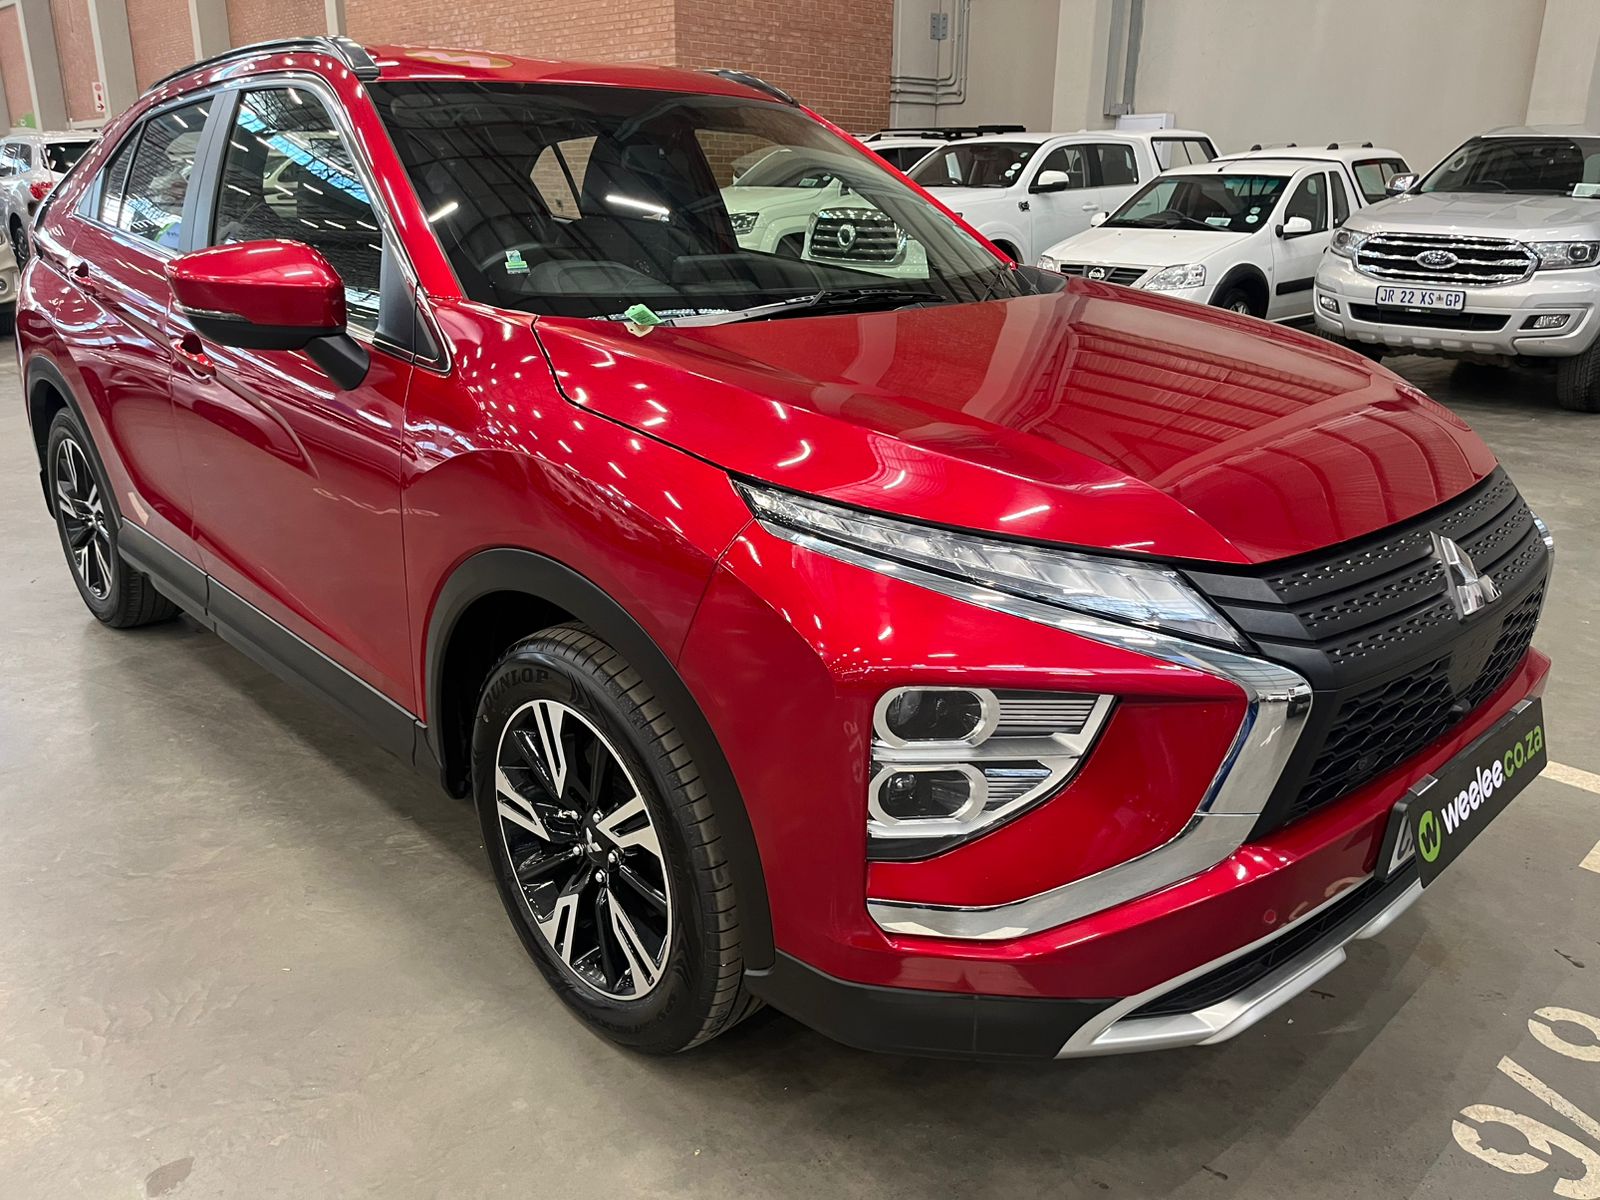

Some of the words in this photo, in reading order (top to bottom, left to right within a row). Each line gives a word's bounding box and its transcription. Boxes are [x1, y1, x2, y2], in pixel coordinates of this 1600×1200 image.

[1380, 288, 1395, 303] JR
[1400, 290, 1415, 304] 22
[1419, 291, 1435, 306] XS
[1445, 293, 1461, 307] GP
[483, 667, 550, 712] DUNLOP
[1440, 725, 1543, 835] weelee.co.za
